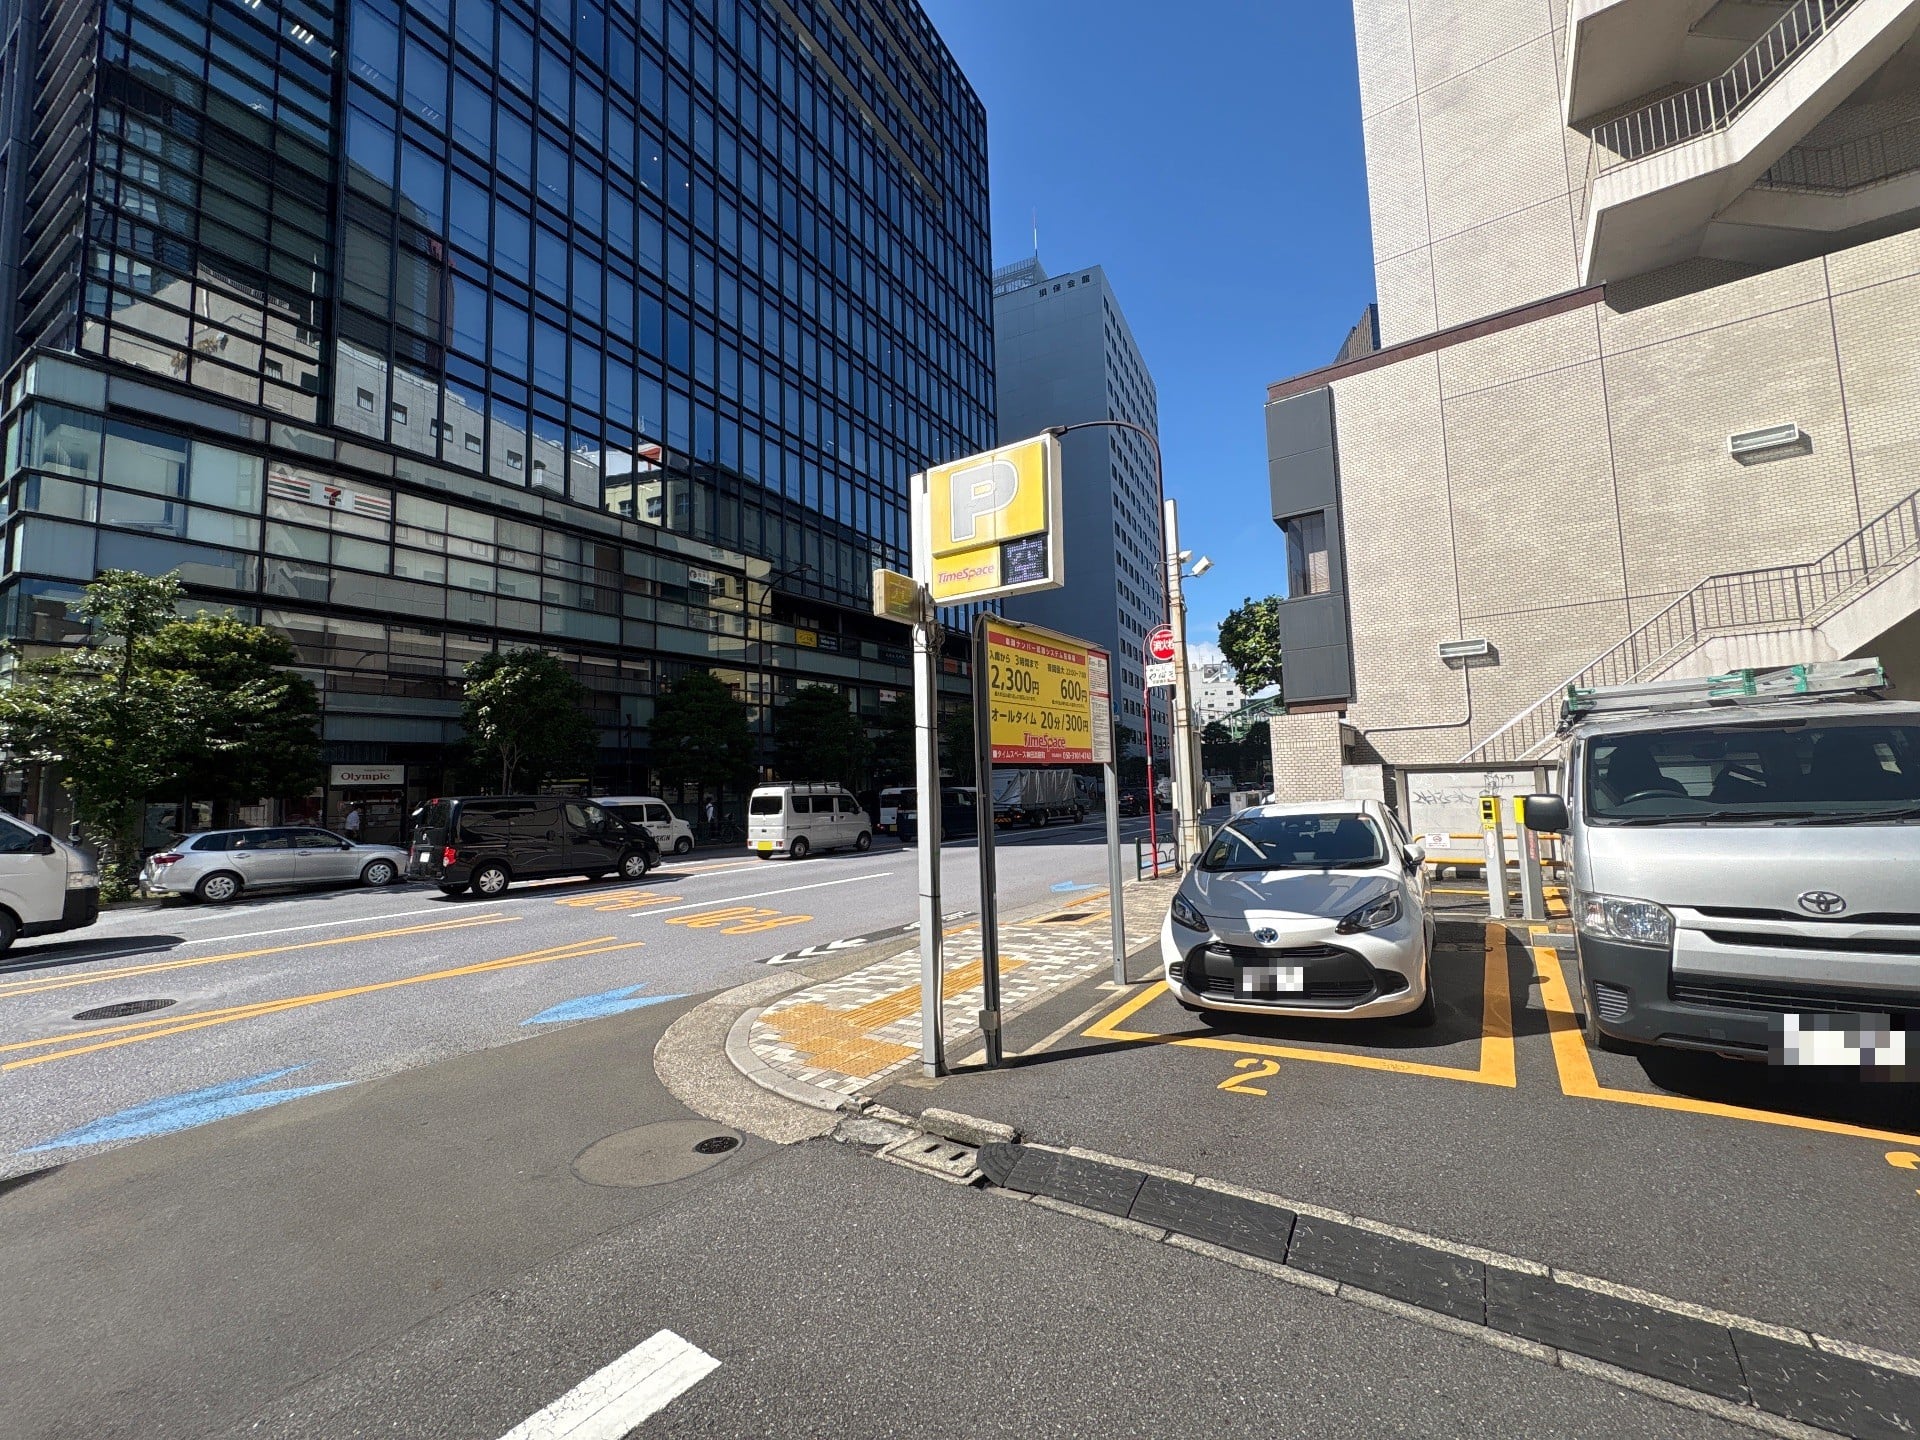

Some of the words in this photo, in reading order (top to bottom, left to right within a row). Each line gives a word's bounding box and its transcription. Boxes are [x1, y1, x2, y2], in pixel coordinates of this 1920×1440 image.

[950, 460, 1019, 543] P
[938, 564, 995, 585] TimeSpace
[991, 664, 1040, 695] 2,300円
[1060, 679, 1088, 703] 600円
[991, 708, 1037, 725] オールタイム
[1040, 711, 1089, 732] 20分/300円
[1023, 731, 1066, 752] TimeSpace
[341, 772, 391, 781] Olympic
[1216, 1058, 1281, 1096] 2
